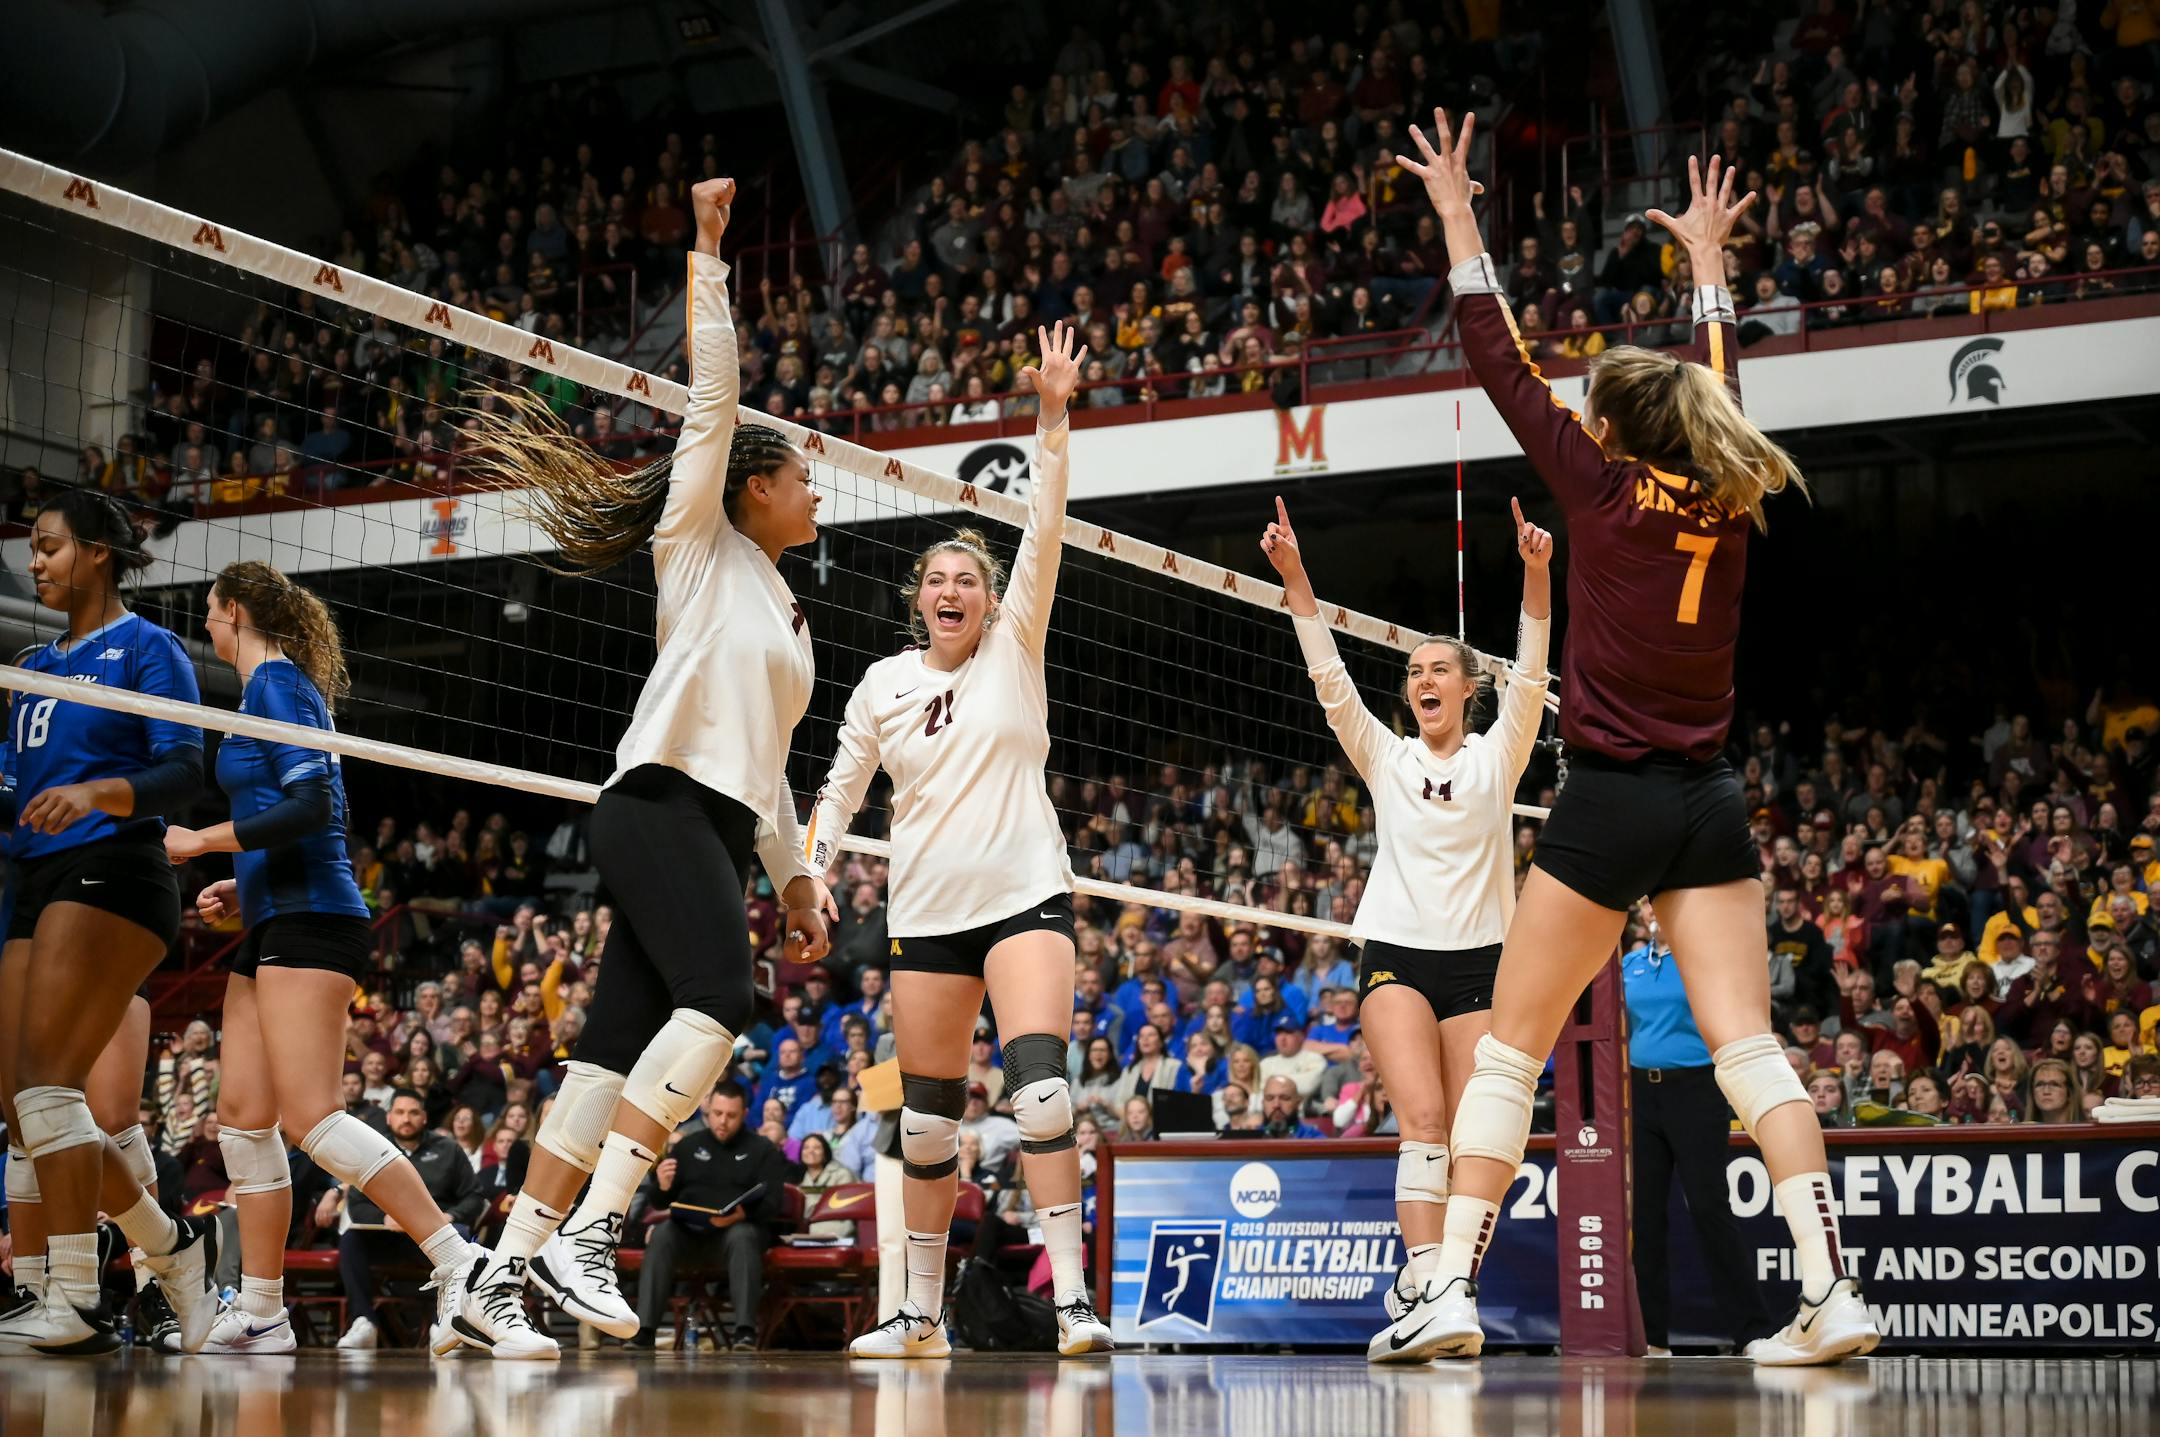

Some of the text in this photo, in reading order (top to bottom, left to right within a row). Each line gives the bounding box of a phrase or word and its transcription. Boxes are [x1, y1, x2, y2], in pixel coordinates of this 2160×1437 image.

[63, 178, 101, 209] M
[192, 223, 226, 253] M
[313, 264, 344, 293] M
[424, 302, 452, 330] M
[529, 339, 555, 365] M
[626, 372, 651, 397] M
[804, 432, 825, 455] M
[1274, 404, 1328, 466] M
[884, 458, 904, 481] M
[959, 485, 978, 506] M
[1098, 531, 1116, 552] M
[1162, 551, 1179, 573] M
[1223, 572, 1238, 592] M
[1674, 531, 1719, 625] 7
[1334, 608, 1348, 628] M
[1386, 625, 1399, 643] M
[924, 688, 955, 737] 21
[16, 698, 58, 754] 18
[1367, 971, 1398, 988] M
[1236, 1190, 1280, 1204] NCAA
[1231, 1221, 1402, 1237] 2019 DIVISION I WOMEN'S
[1228, 1238, 1398, 1274] VOLLEYBALL
[1578, 1215, 1605, 1309] senoh
[1757, 1245, 2146, 1281] FIT AND SECOND
[1221, 1275, 1374, 1300] CHAMPIONSHIP
